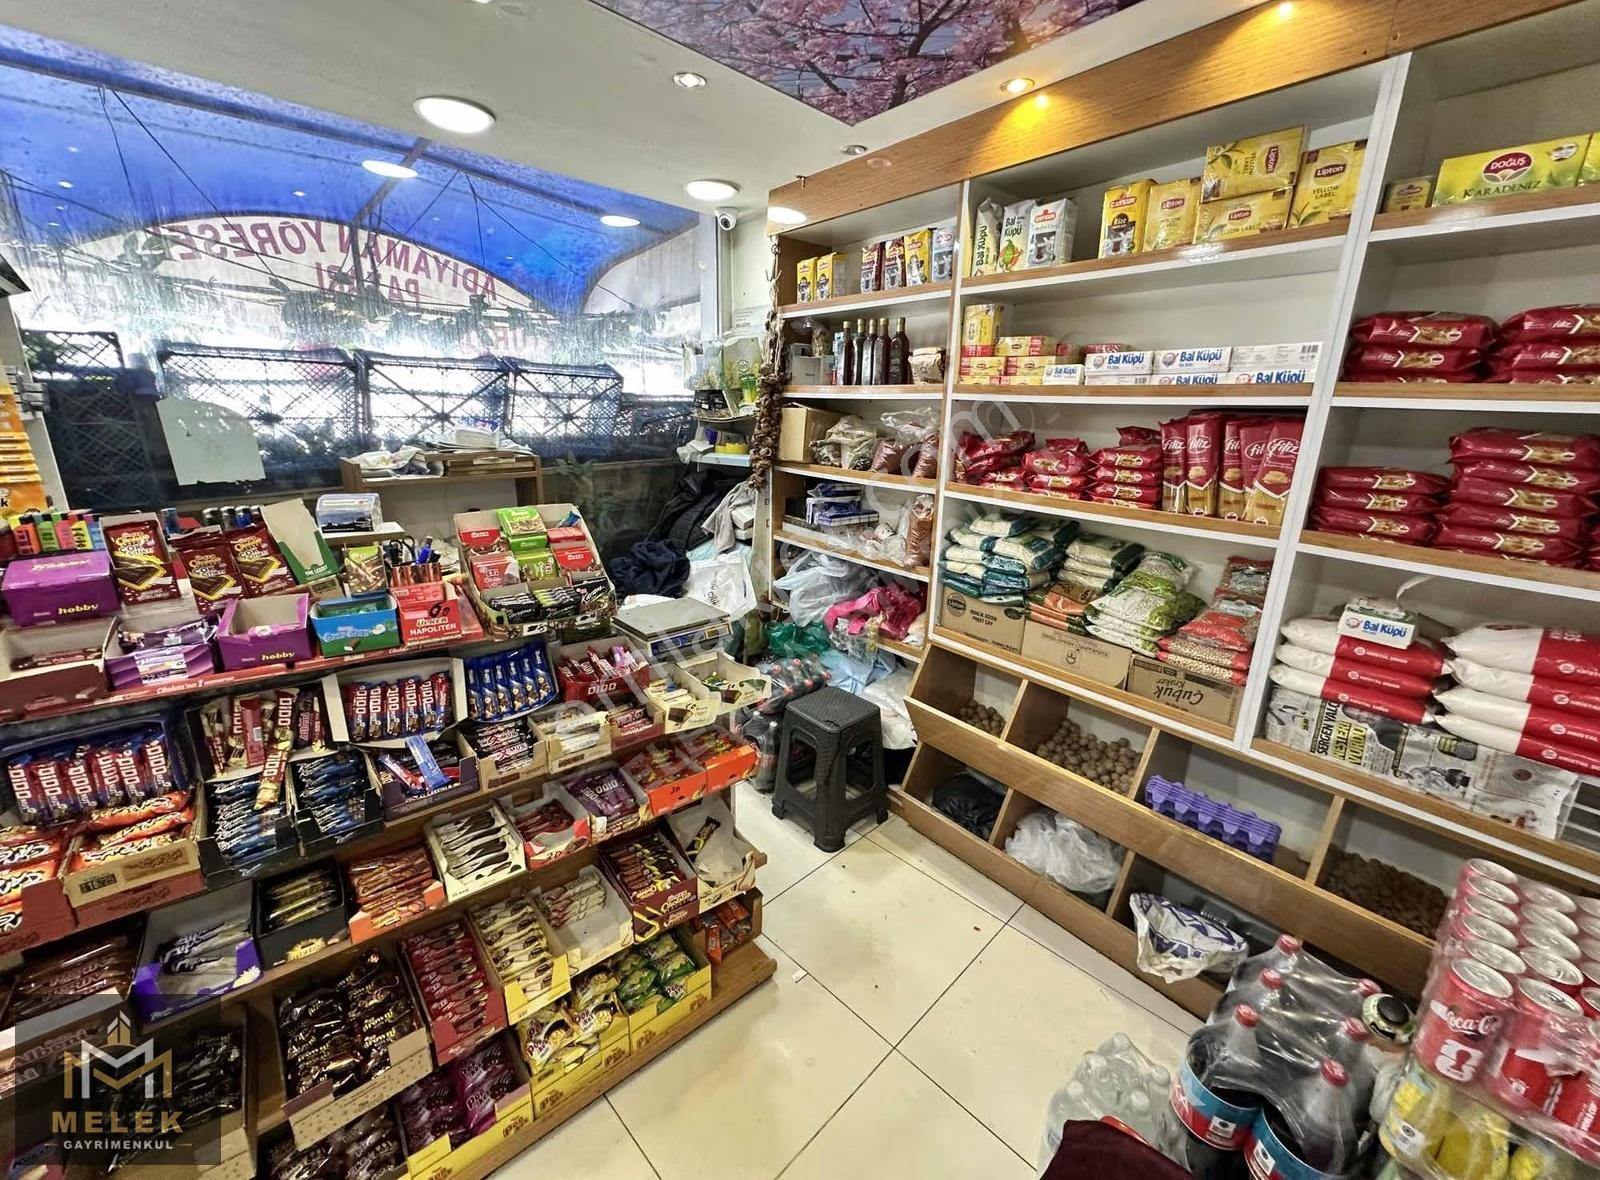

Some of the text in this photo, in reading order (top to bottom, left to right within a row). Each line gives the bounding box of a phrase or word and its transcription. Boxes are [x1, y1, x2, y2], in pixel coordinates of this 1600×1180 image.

[1317, 166, 1344, 177] Lipton
[1108, 353, 1144, 366] Bal Küpü
[1180, 349, 1222, 363] Bal Küpü
[1256, 372, 1273, 384] Bal
[1269, 440, 1299, 457] filiz
[58, 604, 98, 615] hobby
[1363, 620, 1407, 638] Bal Küpü
[261, 651, 295, 661] hobby
[588, 682, 617, 695] DIDO
[1316, 723, 1333, 755] SERGEN
